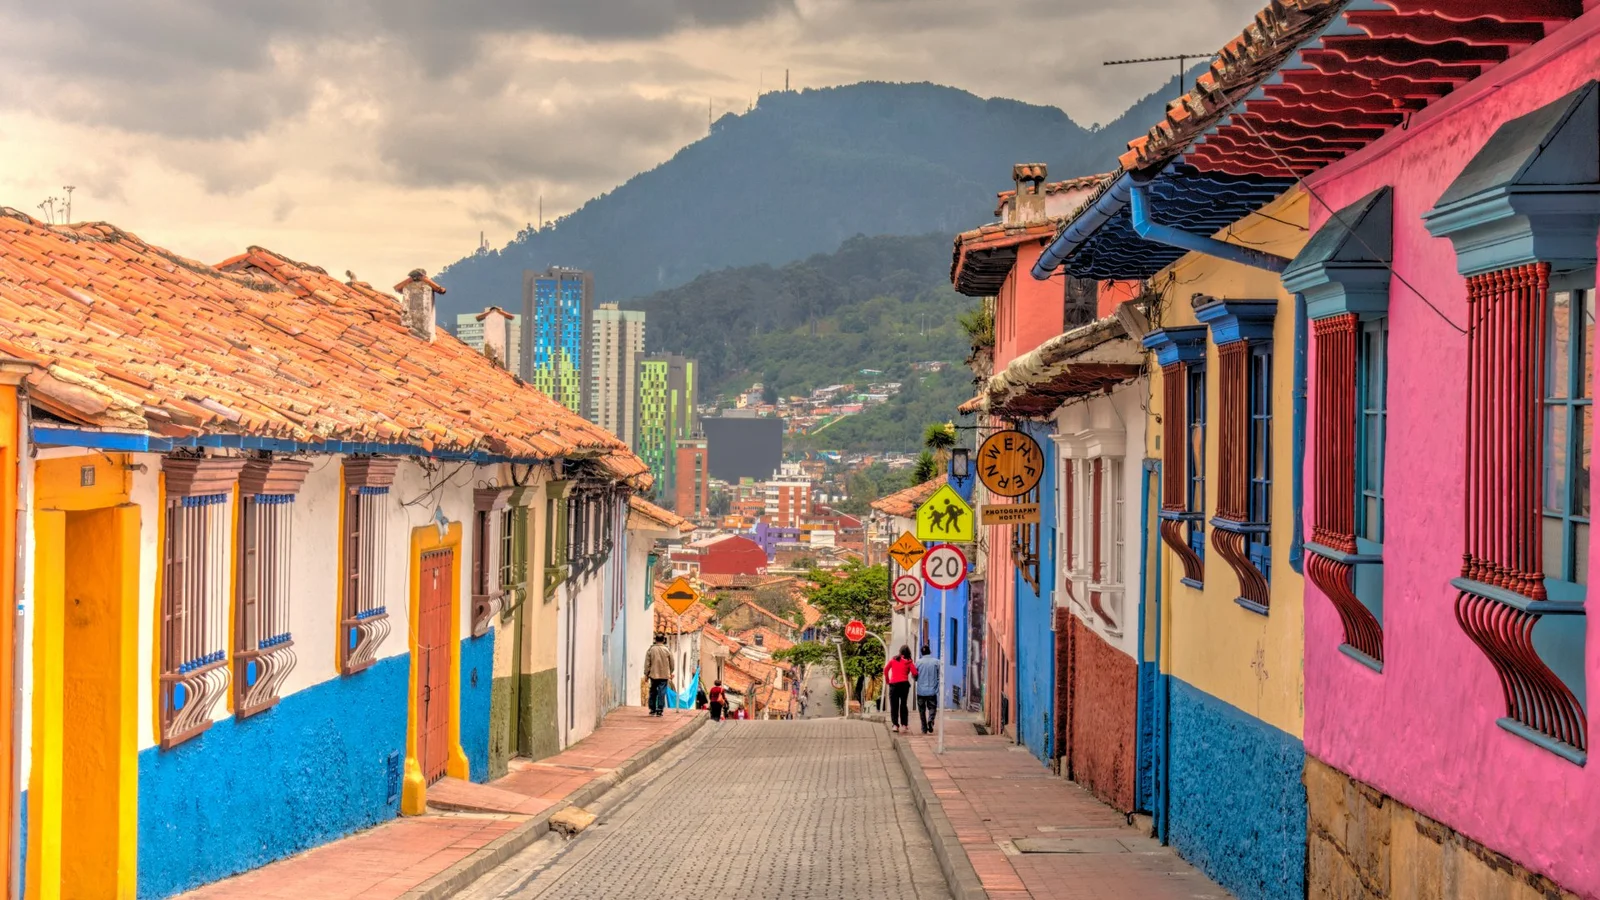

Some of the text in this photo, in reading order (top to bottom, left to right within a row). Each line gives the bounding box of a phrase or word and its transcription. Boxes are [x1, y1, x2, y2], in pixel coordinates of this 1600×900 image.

[985, 507, 1037, 515] PHOTOGRAPHY
[930, 556, 959, 578] 20
[897, 583, 916, 597] 20
[847, 626, 863, 635] PARE
